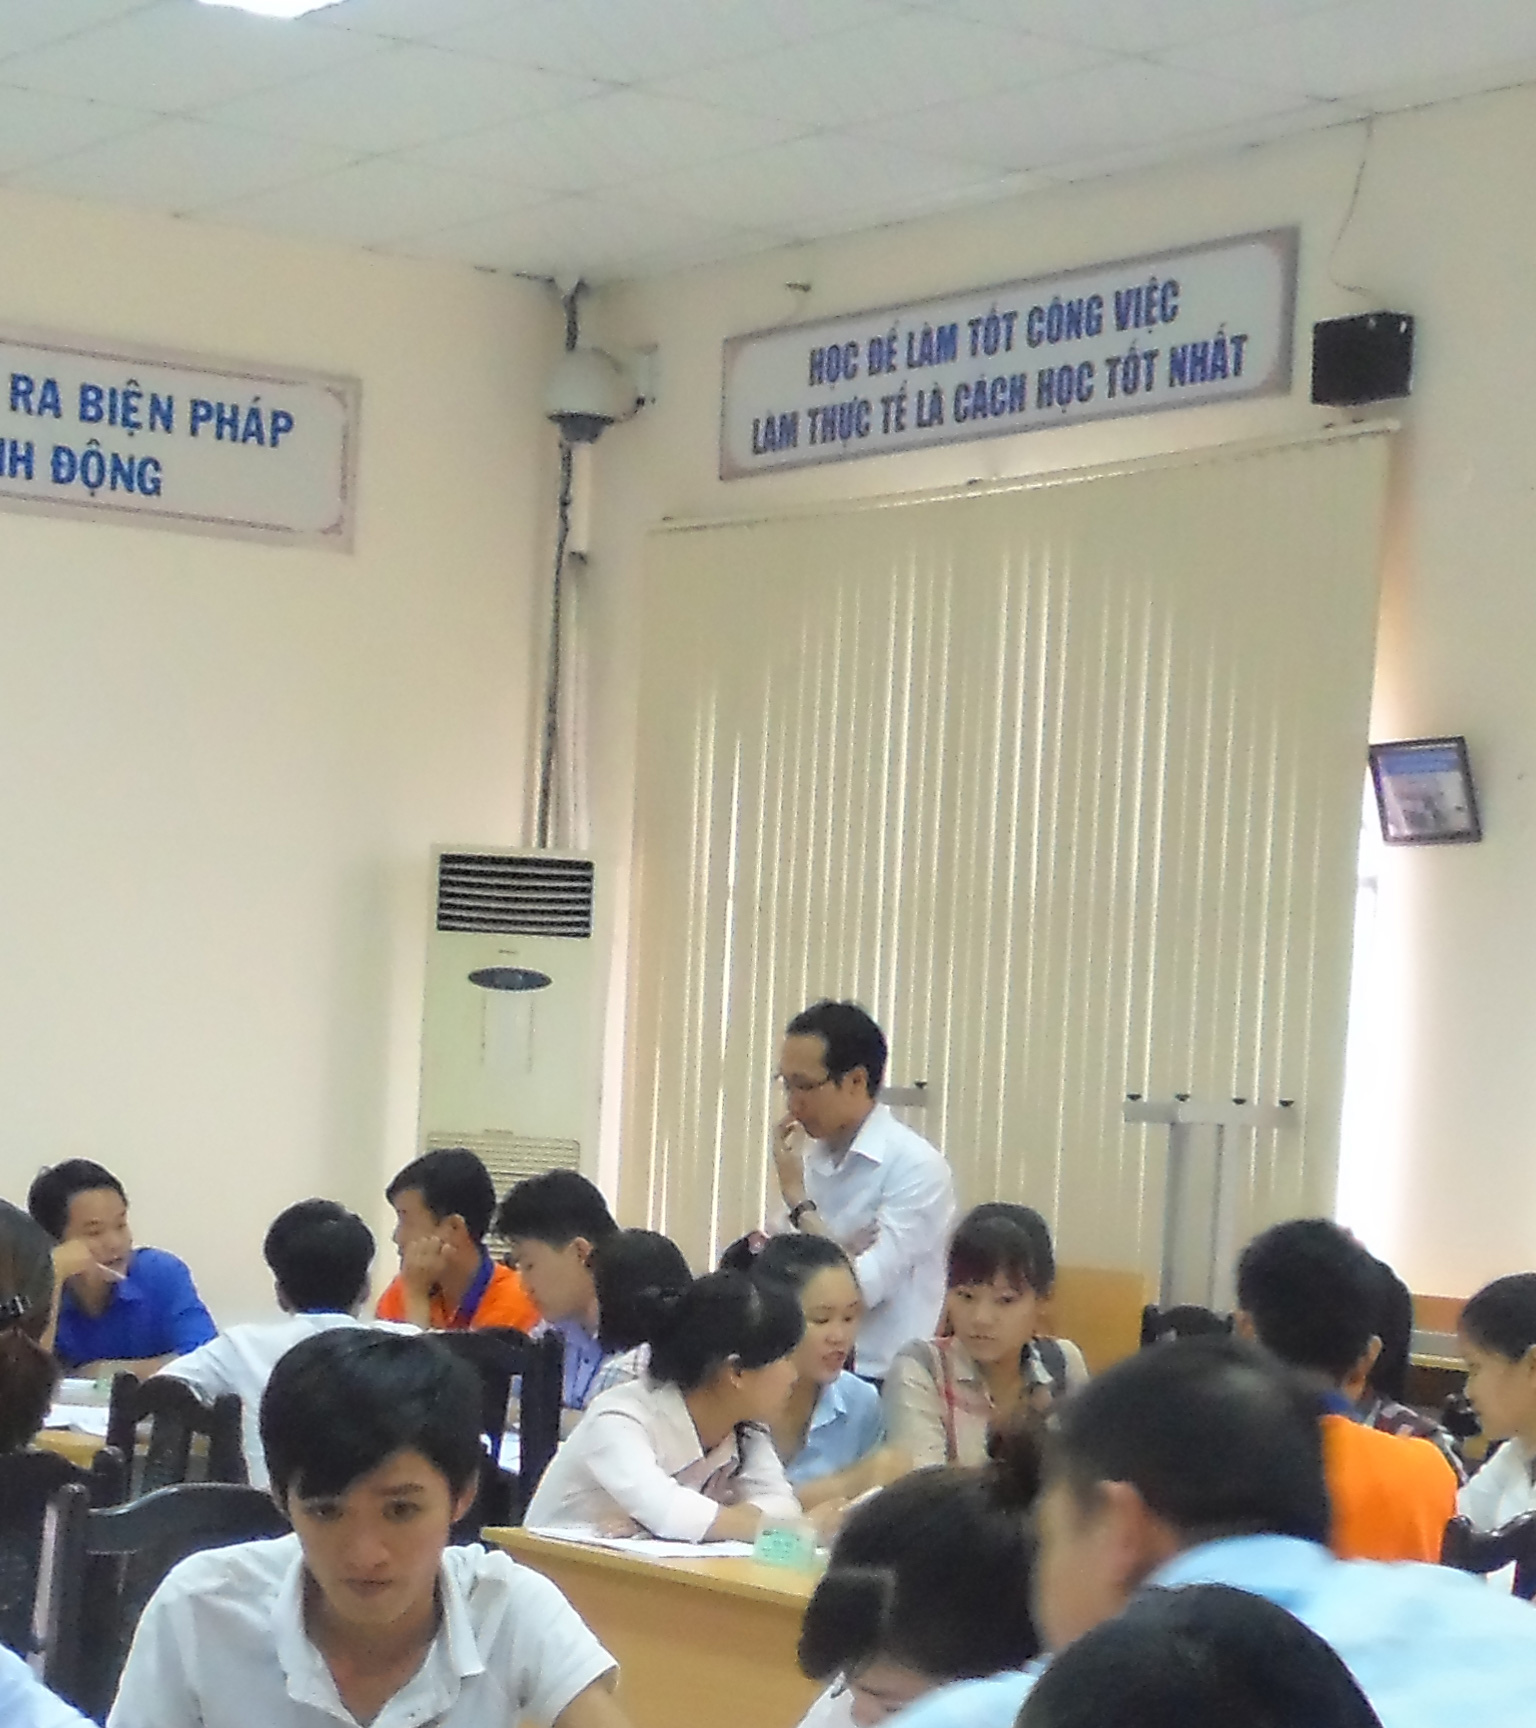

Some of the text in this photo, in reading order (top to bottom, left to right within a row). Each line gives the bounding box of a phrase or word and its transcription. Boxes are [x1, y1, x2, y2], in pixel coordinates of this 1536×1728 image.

[809, 341, 858, 389] HỌC
[1026, 295, 1104, 349] CÔNG
[1115, 276, 1180, 334] VIỆC
[1037, 361, 1095, 413] HỌC
[1106, 338, 1159, 398] TỐT
[1169, 322, 1248, 387] NHẤT
[10, 373, 62, 418] RA
[79, 379, 174, 436] BIỆN
[189, 396, 294, 447] PHÁP
[51, 438, 161, 496] ĐỘNG
